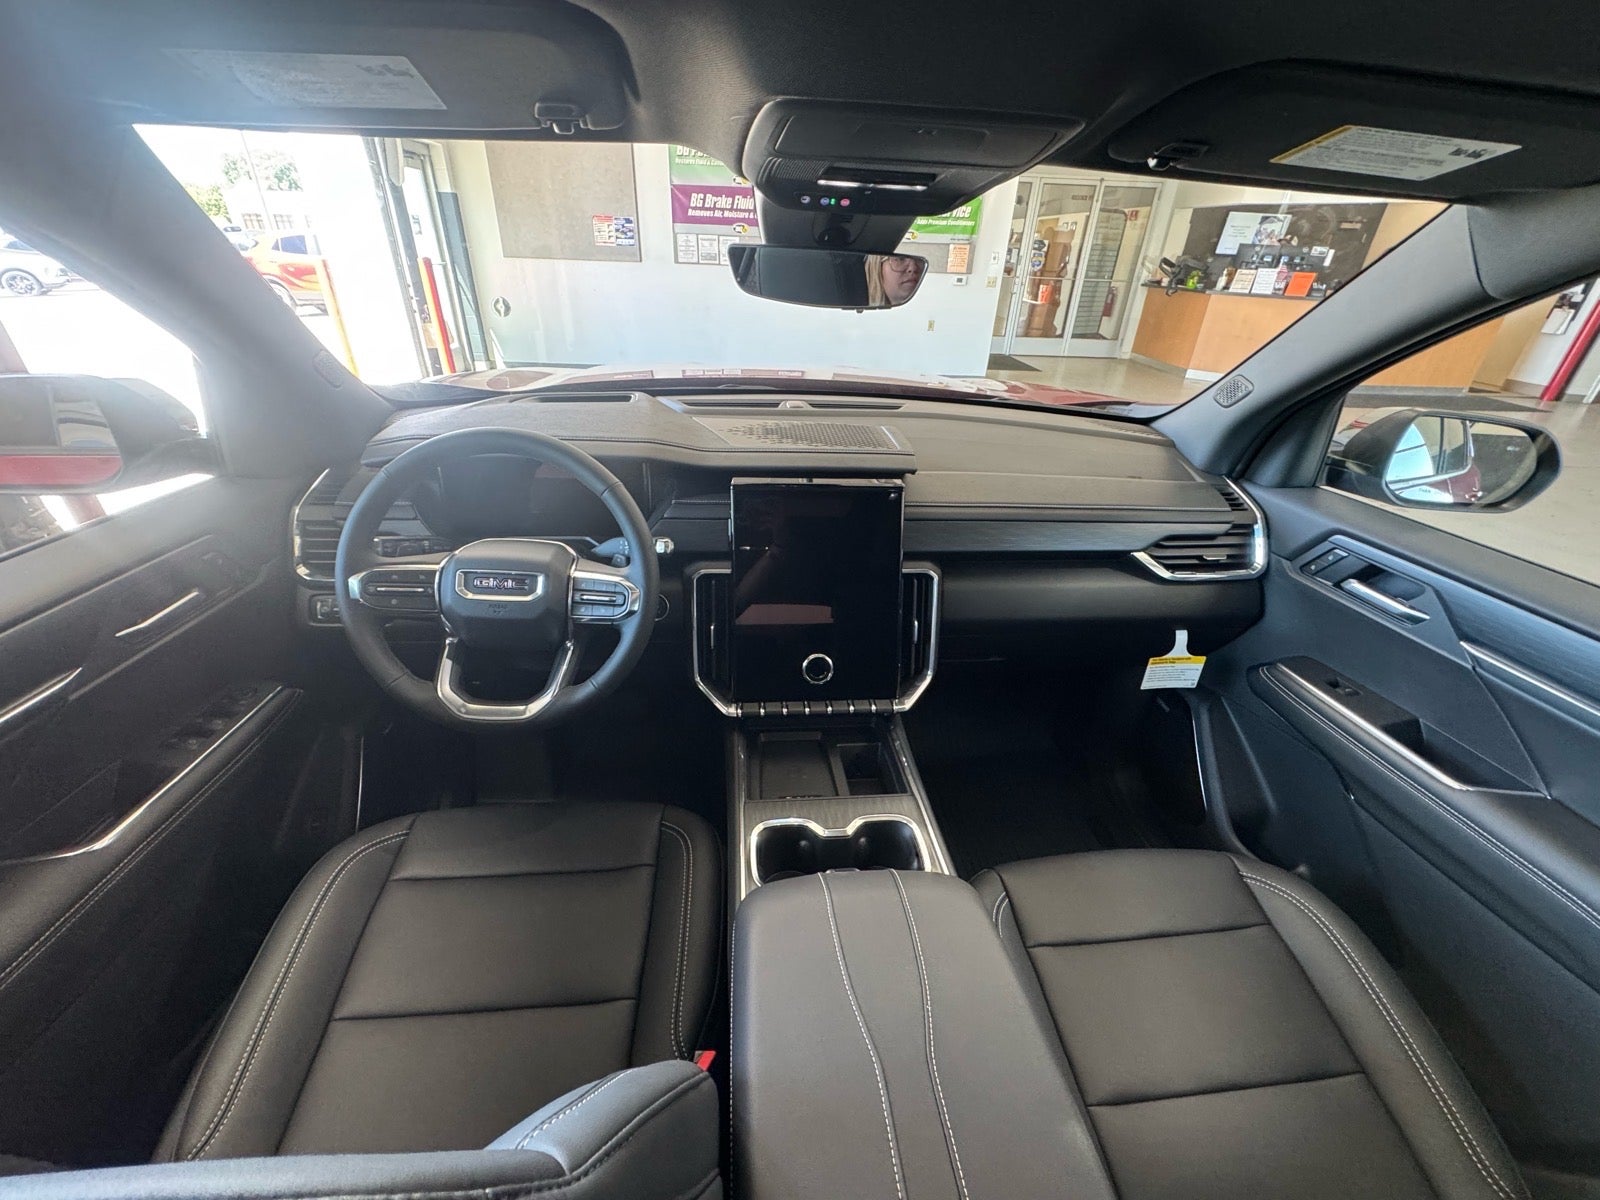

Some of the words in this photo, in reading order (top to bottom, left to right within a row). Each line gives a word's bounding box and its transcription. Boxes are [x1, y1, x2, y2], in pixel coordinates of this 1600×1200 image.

[690, 192, 704, 207] BG
[705, 193, 732, 209] Brake
[733, 195, 755, 210] Fluid
[688, 208, 713, 217] Removes
[723, 210, 749, 219] Moisture
[749, 211, 754, 219] &
[473, 577, 528, 591] GMC
